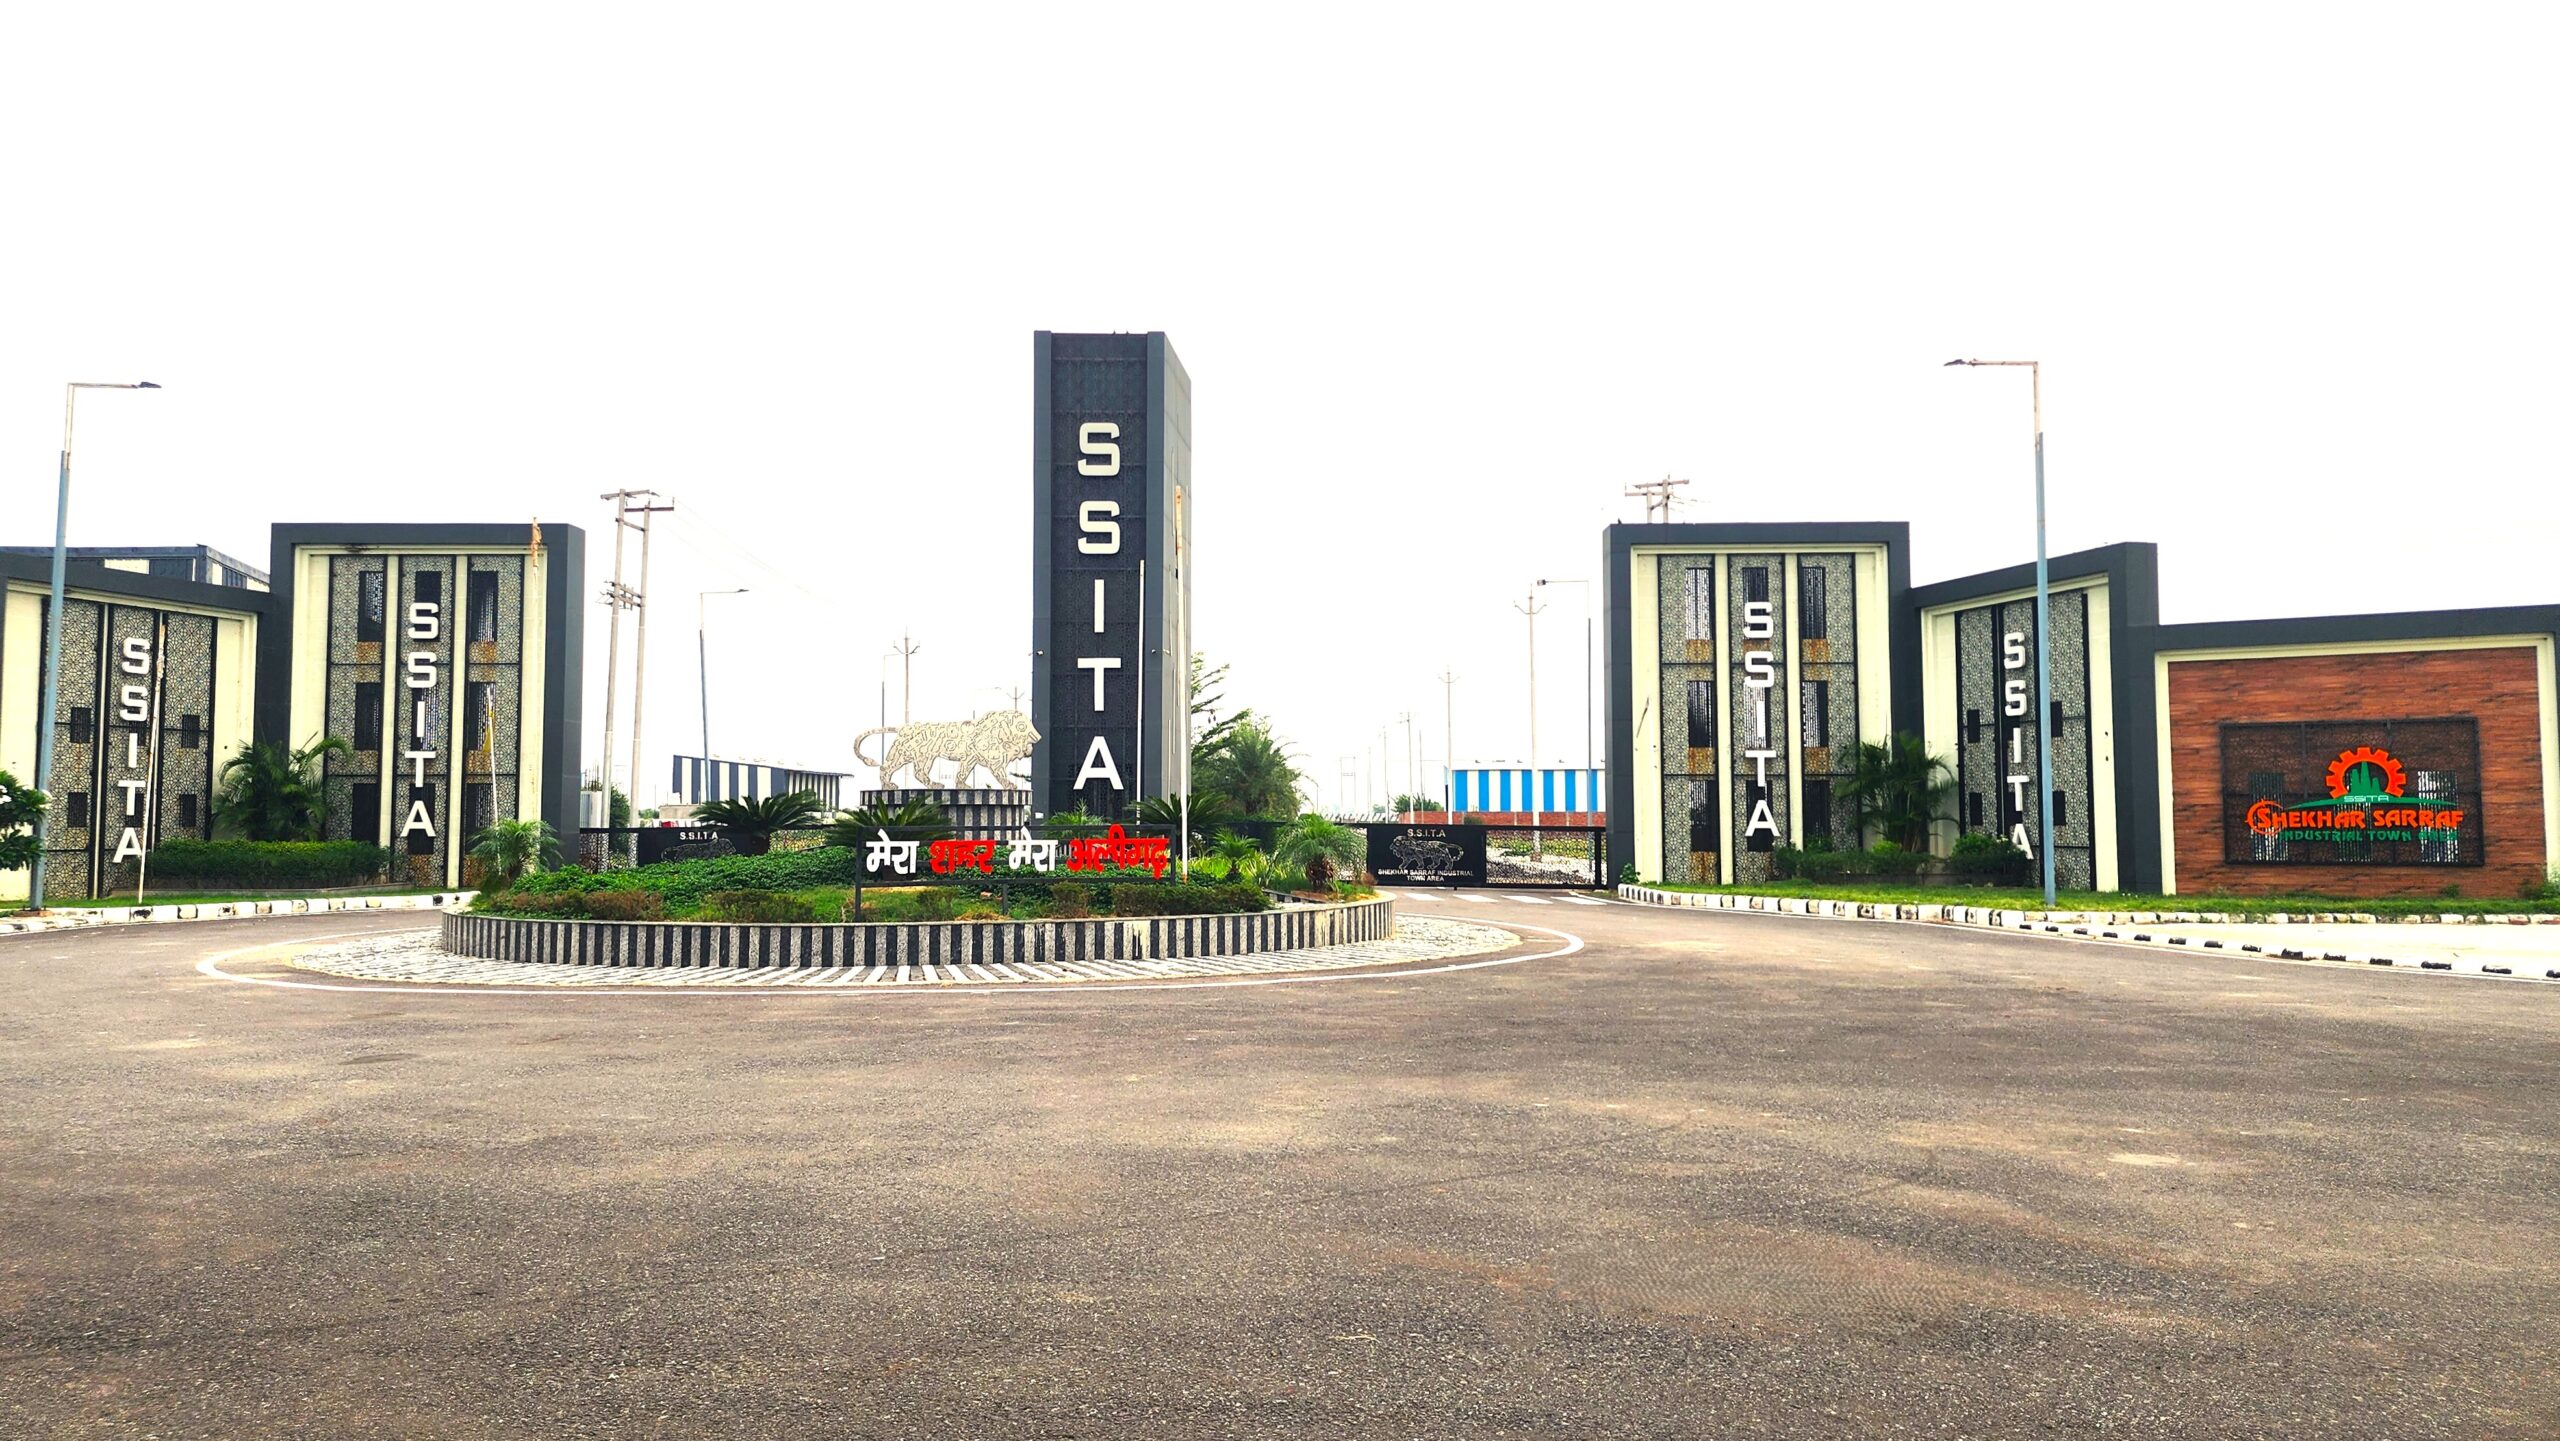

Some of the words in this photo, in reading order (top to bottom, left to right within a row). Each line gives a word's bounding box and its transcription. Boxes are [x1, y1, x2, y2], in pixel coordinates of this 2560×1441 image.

[1073, 422, 1124, 790] SSITA
[1743, 601, 1780, 837] SSITA
[112, 637, 150, 863] SSITA
[401, 602, 440, 837] SSITA
[2004, 632, 2034, 859] SSITA
[2254, 807, 2366, 829] SHEKHAR
[2373, 810, 2464, 829] SARRAF
[2344, 795, 2389, 803] SSITA
[866, 828, 920, 874] मेरा
[1008, 826, 1058, 872] मेरा
[2369, 831, 2412, 841] TOWN
